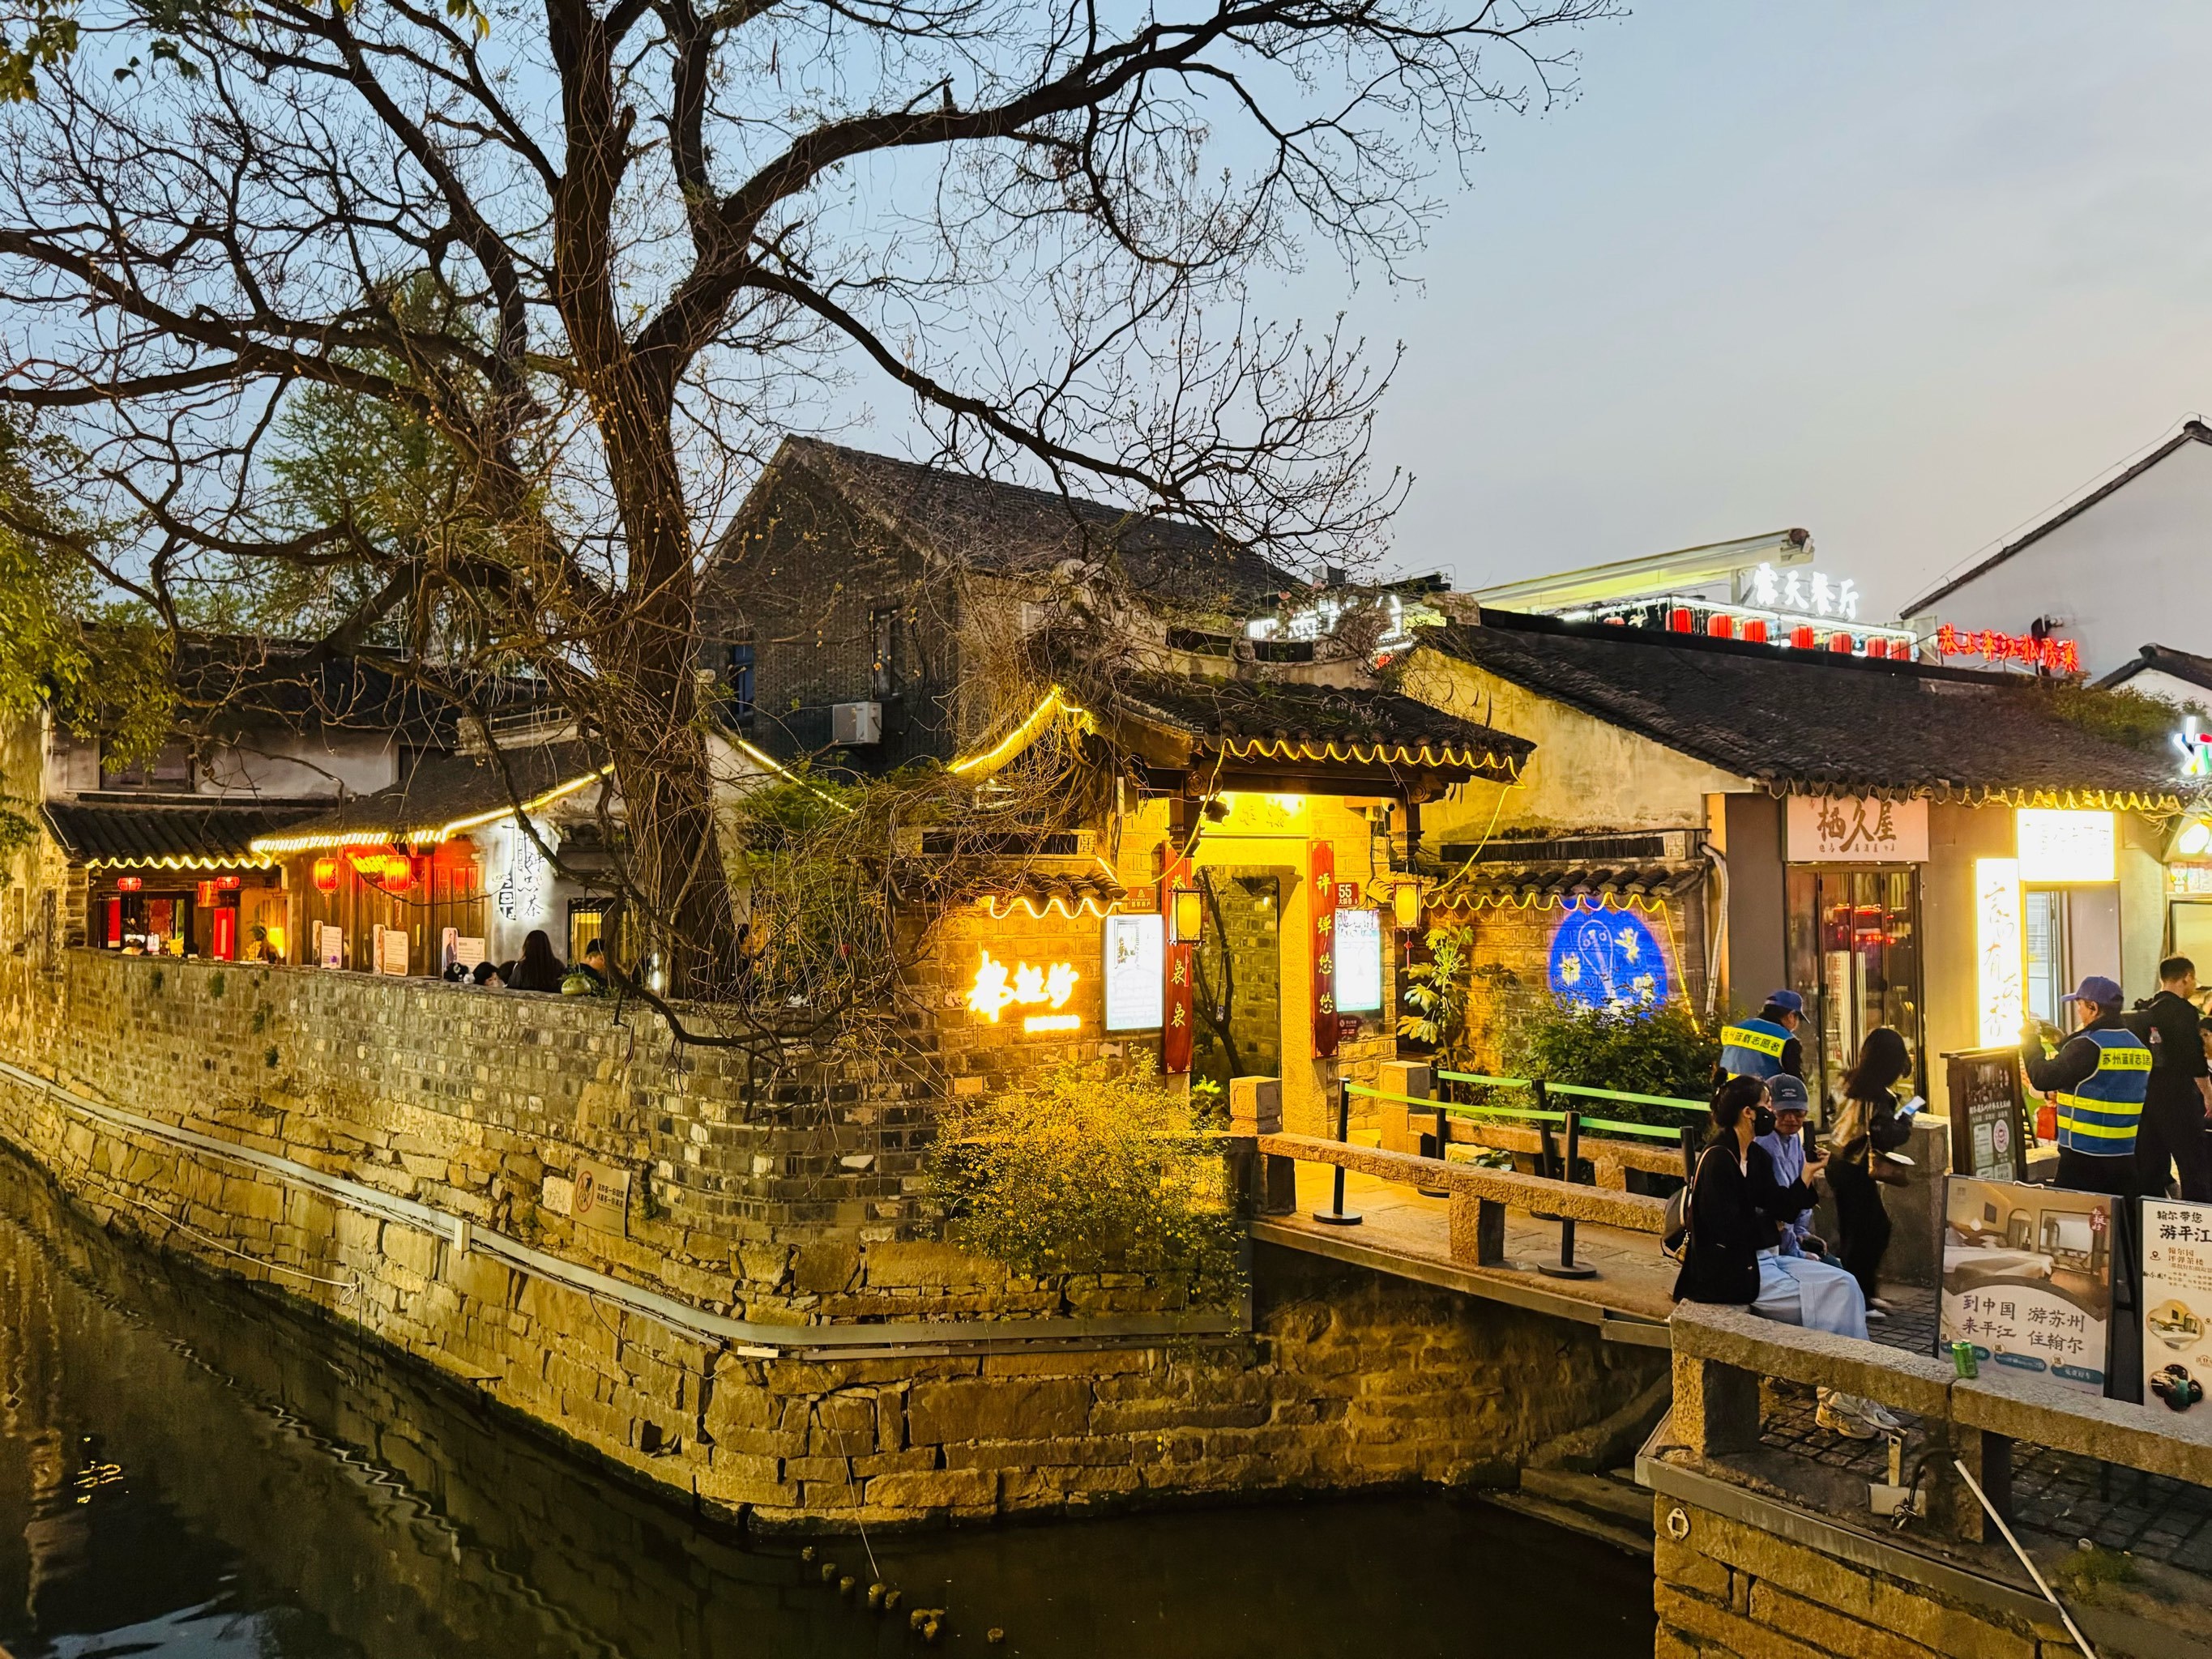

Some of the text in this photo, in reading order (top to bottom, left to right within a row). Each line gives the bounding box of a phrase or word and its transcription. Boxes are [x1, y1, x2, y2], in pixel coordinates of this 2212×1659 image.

[1339, 884, 1352, 898] 55
[2157, 1210, 2203, 1223] 翰尔带您
[2159, 1224, 2212, 1243] 游平江
[1962, 1294, 2085, 1333] 到中国 游苏州
[1962, 1316, 2085, 1354] 来平江 住翰尔
